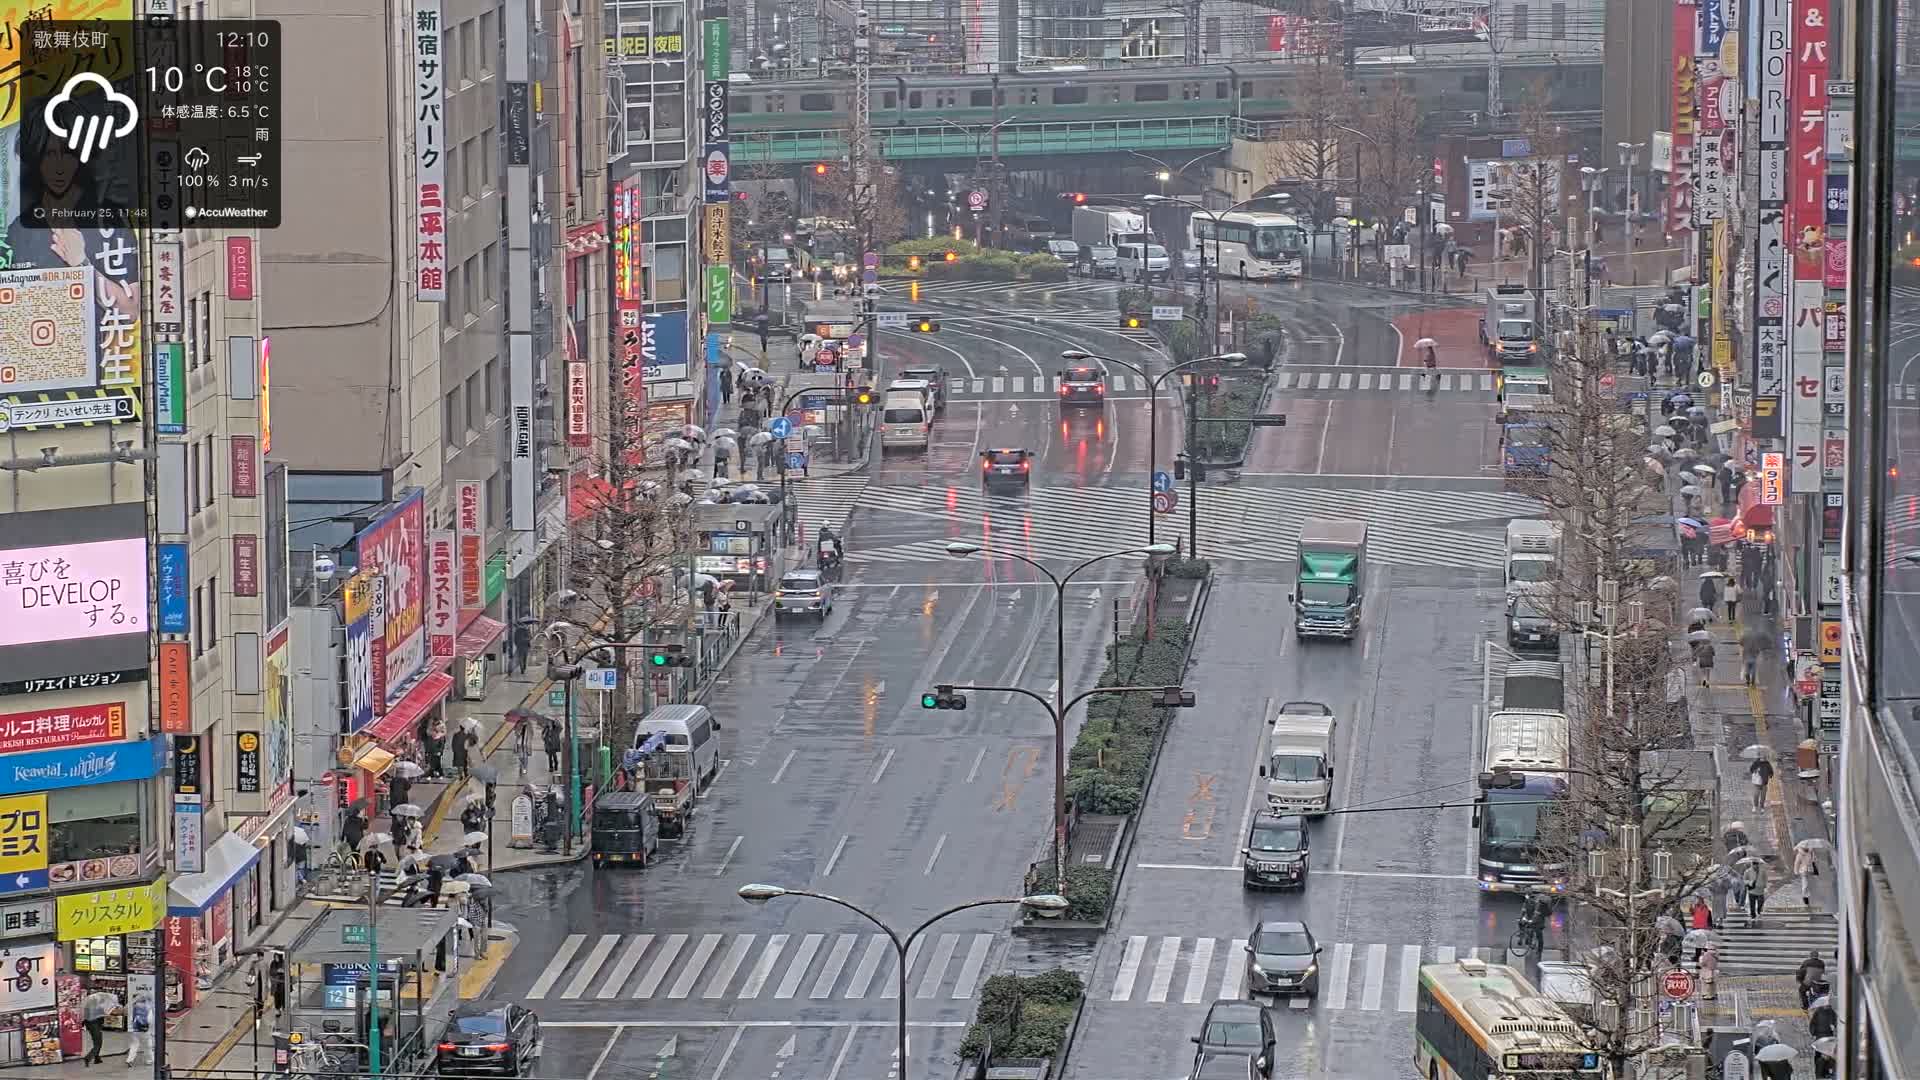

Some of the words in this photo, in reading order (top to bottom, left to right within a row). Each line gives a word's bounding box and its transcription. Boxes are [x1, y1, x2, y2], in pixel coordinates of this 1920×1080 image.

[654, 35, 682, 53] 夜間
[416, 10, 440, 169] 新宿サンパーク
[1707, 86, 1719, 119] アコム
[709, 159, 726, 176] 薬
[1770, 151, 1778, 199] ESOLA
[419, 183, 443, 291] 三平本館
[711, 206, 725, 262] 肉汁水餃子
[711, 274, 726, 312] レイク
[160, 323, 177, 332] 3F
[1760, 328, 1775, 381] 大衆酒場
[159, 352, 170, 413] FamilyMart
[1796, 306, 1822, 468] パセラ
[1830, 404, 1843, 413] 5F
[1829, 495, 1840, 504] 3F
[1, 557, 71, 586] 喜びを
[22, 578, 121, 608] DEVELOP
[433, 540, 450, 628] 三平ストア
[0, 714, 70, 737] ルコ料理
[26, 734, 70, 745] RESTAURANT
[1, 809, 41, 833] プロ
[1, 835, 41, 856] ミス
[5, 910, 41, 931] 囲碁
[70, 902, 143, 926] クリスタル
[333, 962, 385, 970] SUBNAE
[327, 989, 344, 1003] 12
